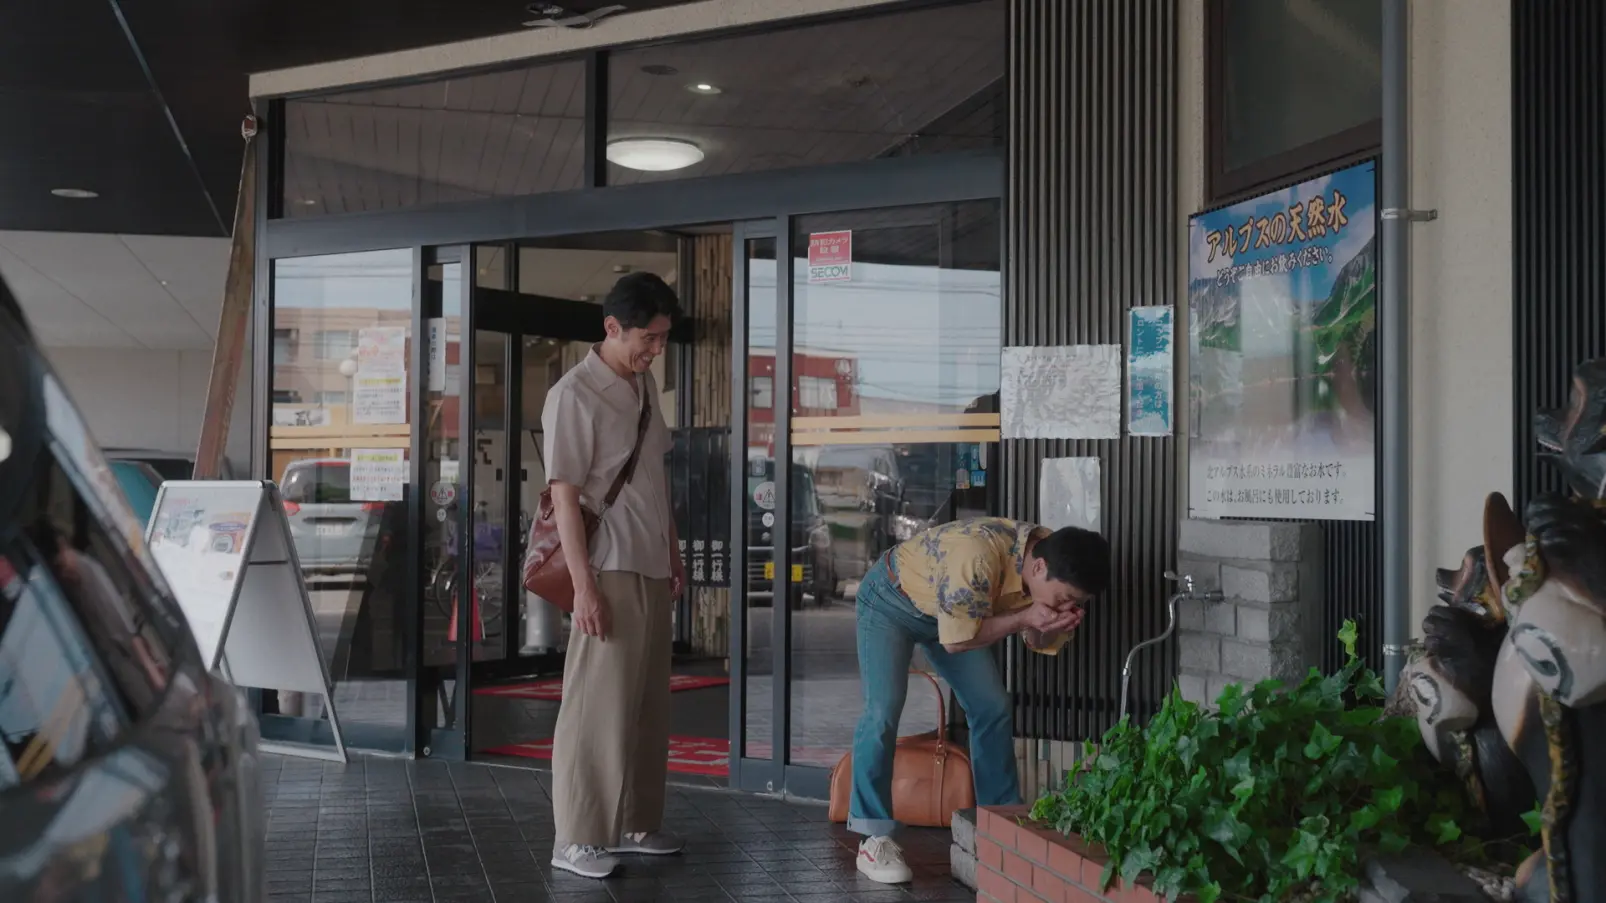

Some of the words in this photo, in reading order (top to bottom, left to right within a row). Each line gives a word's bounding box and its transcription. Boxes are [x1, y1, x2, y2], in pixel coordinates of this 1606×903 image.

[1207, 189, 1348, 263] アルプスの天然水
[811, 266, 848, 278] SECOM
[1216, 245, 1333, 287] どうぞご自由にお飲みください。
[711, 540, 724, 582] 御一行様
